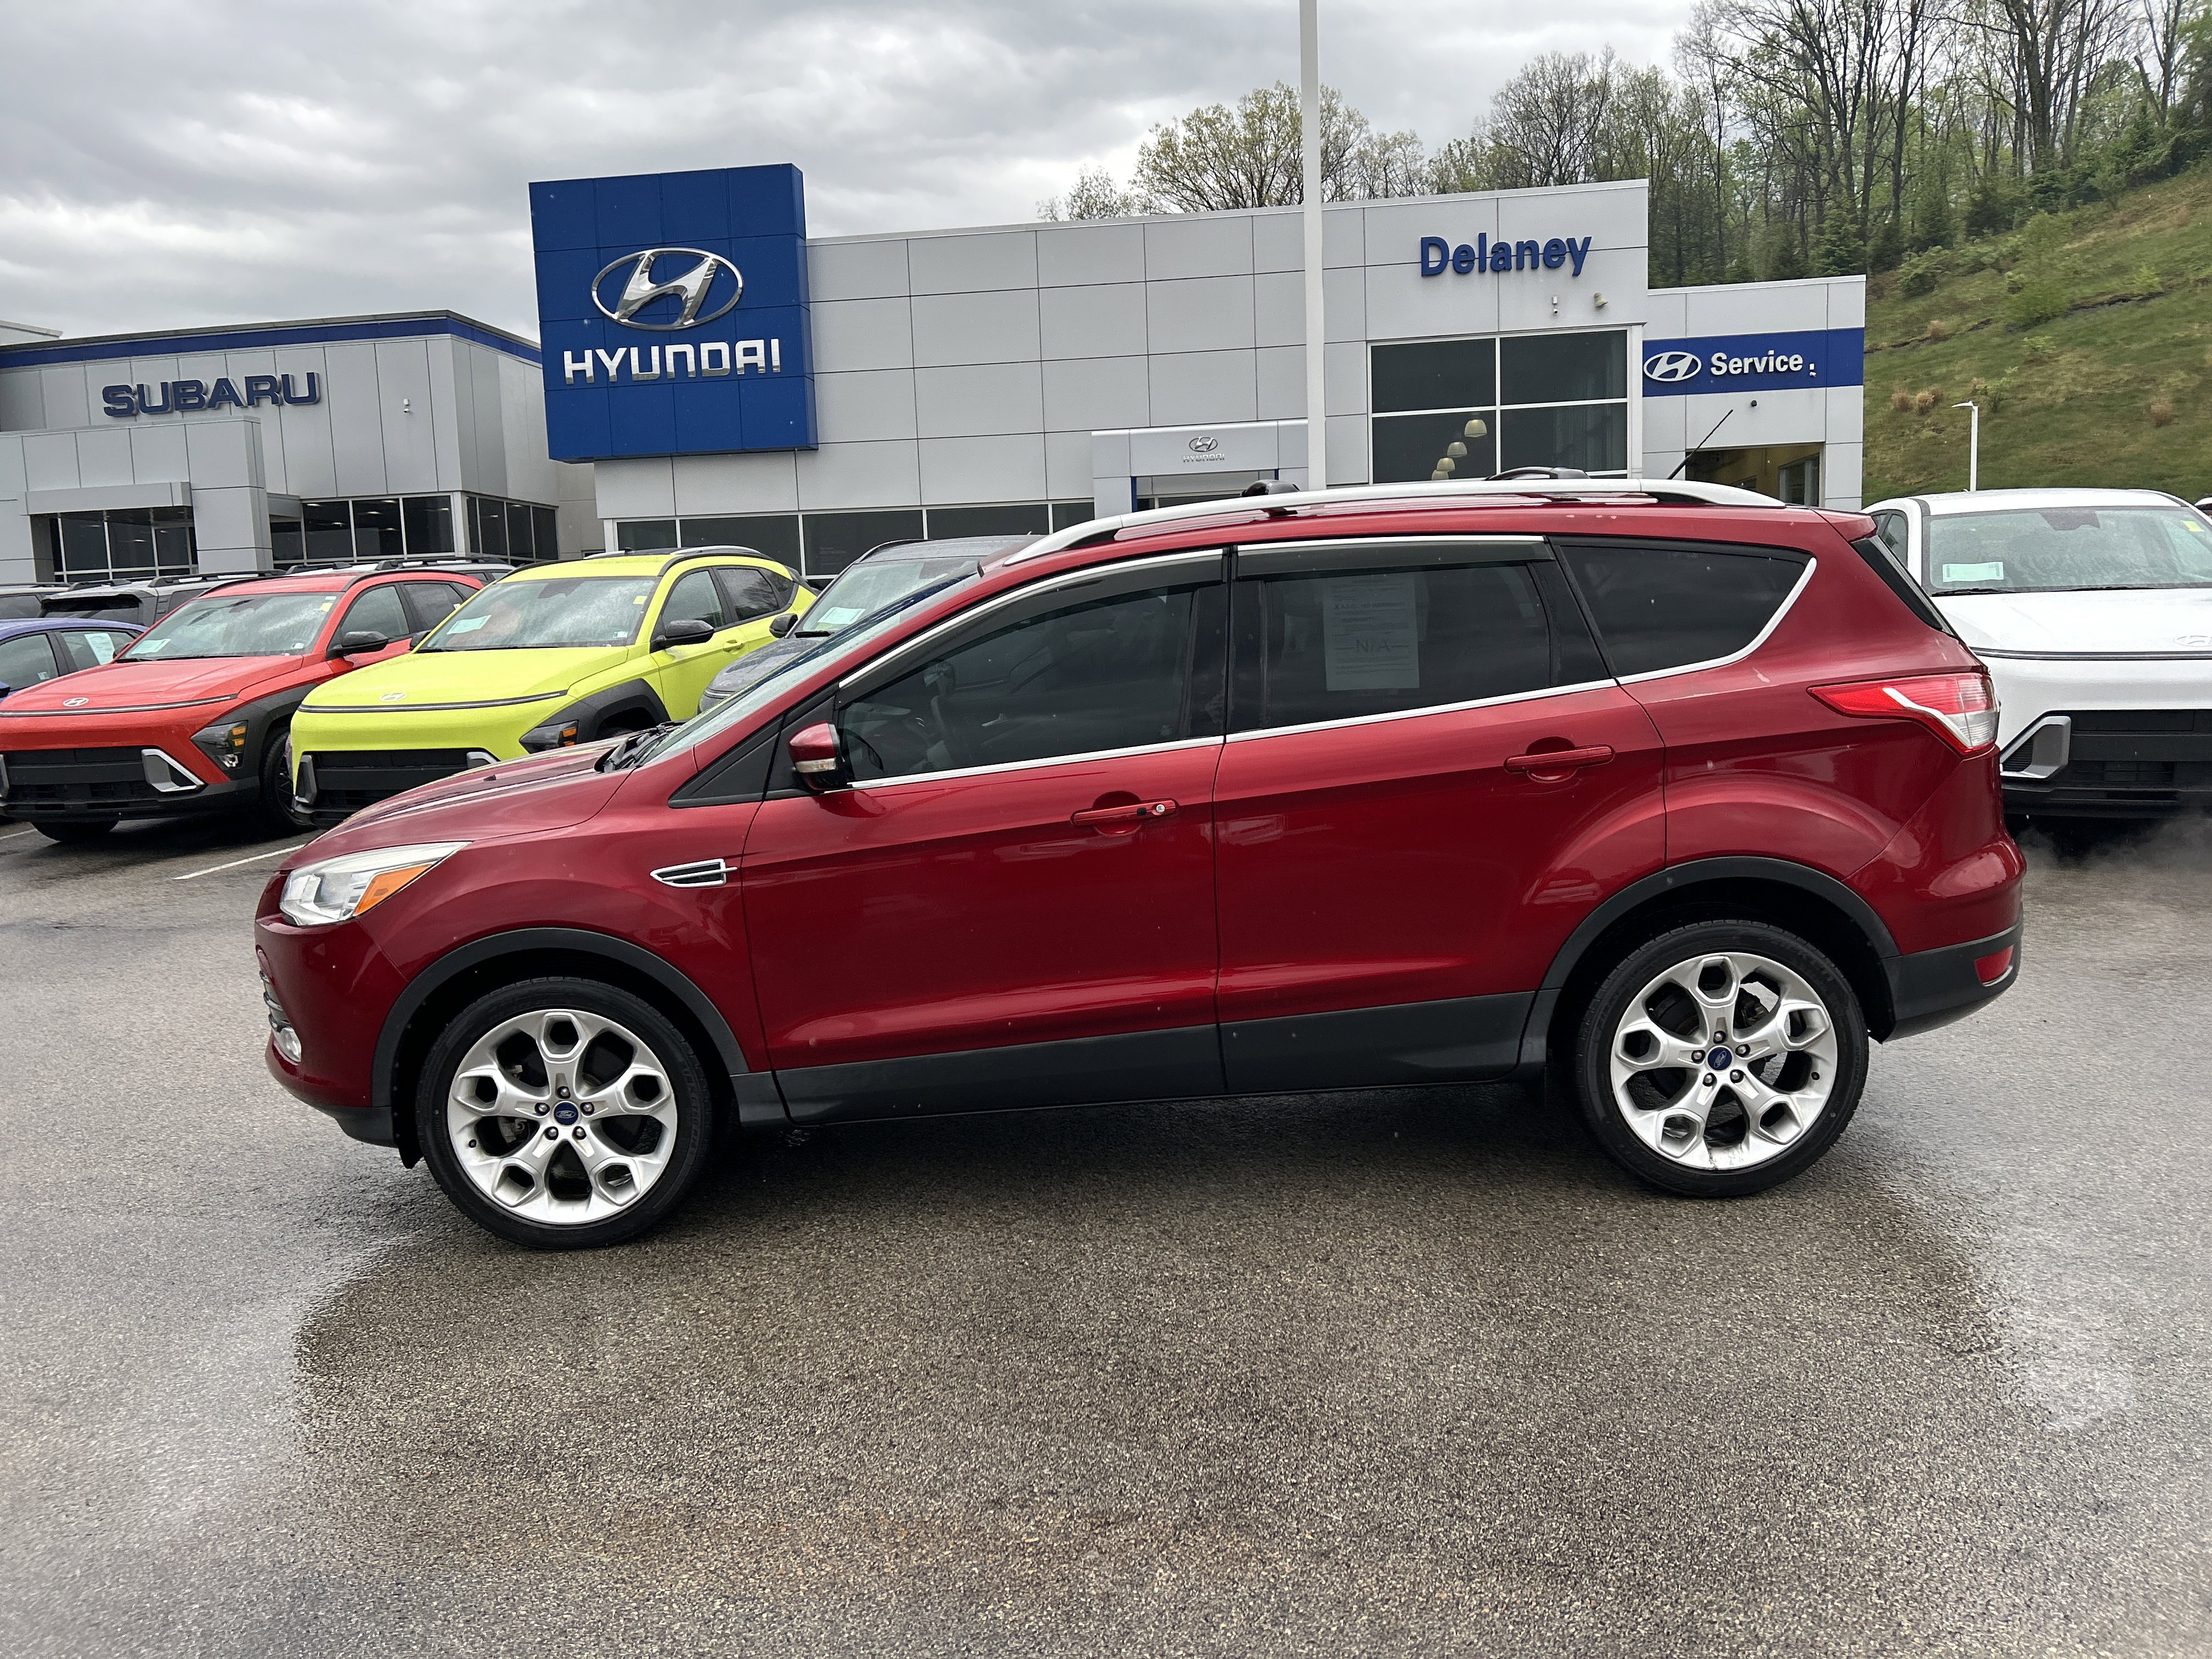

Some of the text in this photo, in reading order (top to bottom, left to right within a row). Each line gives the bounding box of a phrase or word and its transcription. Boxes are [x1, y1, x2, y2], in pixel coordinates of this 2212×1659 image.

[1420, 232, 1592, 276] Delaney
[563, 338, 781, 385] HYUNDAI
[1711, 349, 1803, 376] Service
[103, 372, 319, 416] SUBARU
[1183, 453, 1224, 463] HYUNDAI
